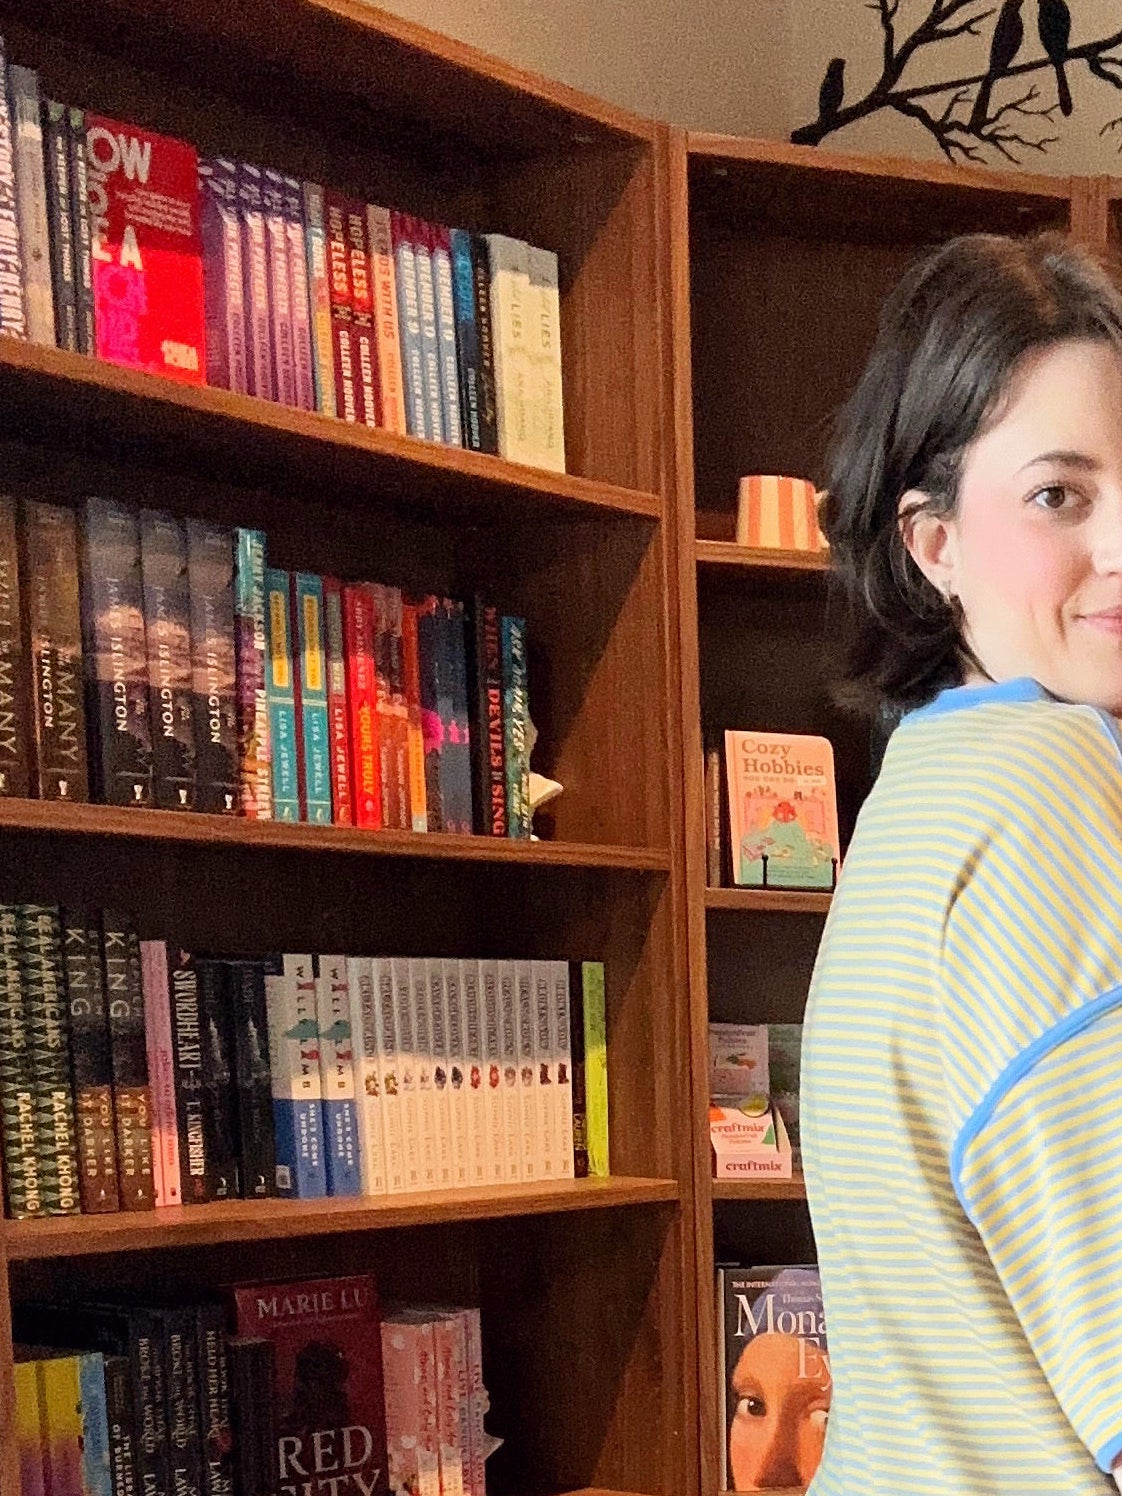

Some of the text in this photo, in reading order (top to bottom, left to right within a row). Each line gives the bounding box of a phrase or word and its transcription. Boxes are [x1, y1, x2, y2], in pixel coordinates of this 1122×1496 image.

[359, 336, 371, 382] COLLEEN
[254, 589, 264, 651] JACKSON
[111, 637, 128, 731] ISLINGTON
[159, 644, 174, 737] ISLINGTON
[207, 652, 221, 743] ISLINGTON
[334, 708, 348, 799] LISA JEWELL
[362, 754, 375, 794] TRULY
[487, 688, 506, 836] DEVILS SING
[741, 739, 792, 760] Cozy
[743, 758, 825, 776] Hobbies
[65, 928, 108, 1127] KING YOU
[104, 932, 150, 1176] KING LIKE
[6, 961, 41, 1211] AMERICANS RACHEL KHONG
[173, 970, 204, 1177] SWORDHEART KINGFISHER
[51, 1092, 73, 1208] RACHEL KHONG
[122, 1118, 134, 1177] DARKER
[725, 1160, 782, 1171] craftmix
[257, 1293, 334, 1319] MARIE
[279, 1425, 373, 1480] RED
